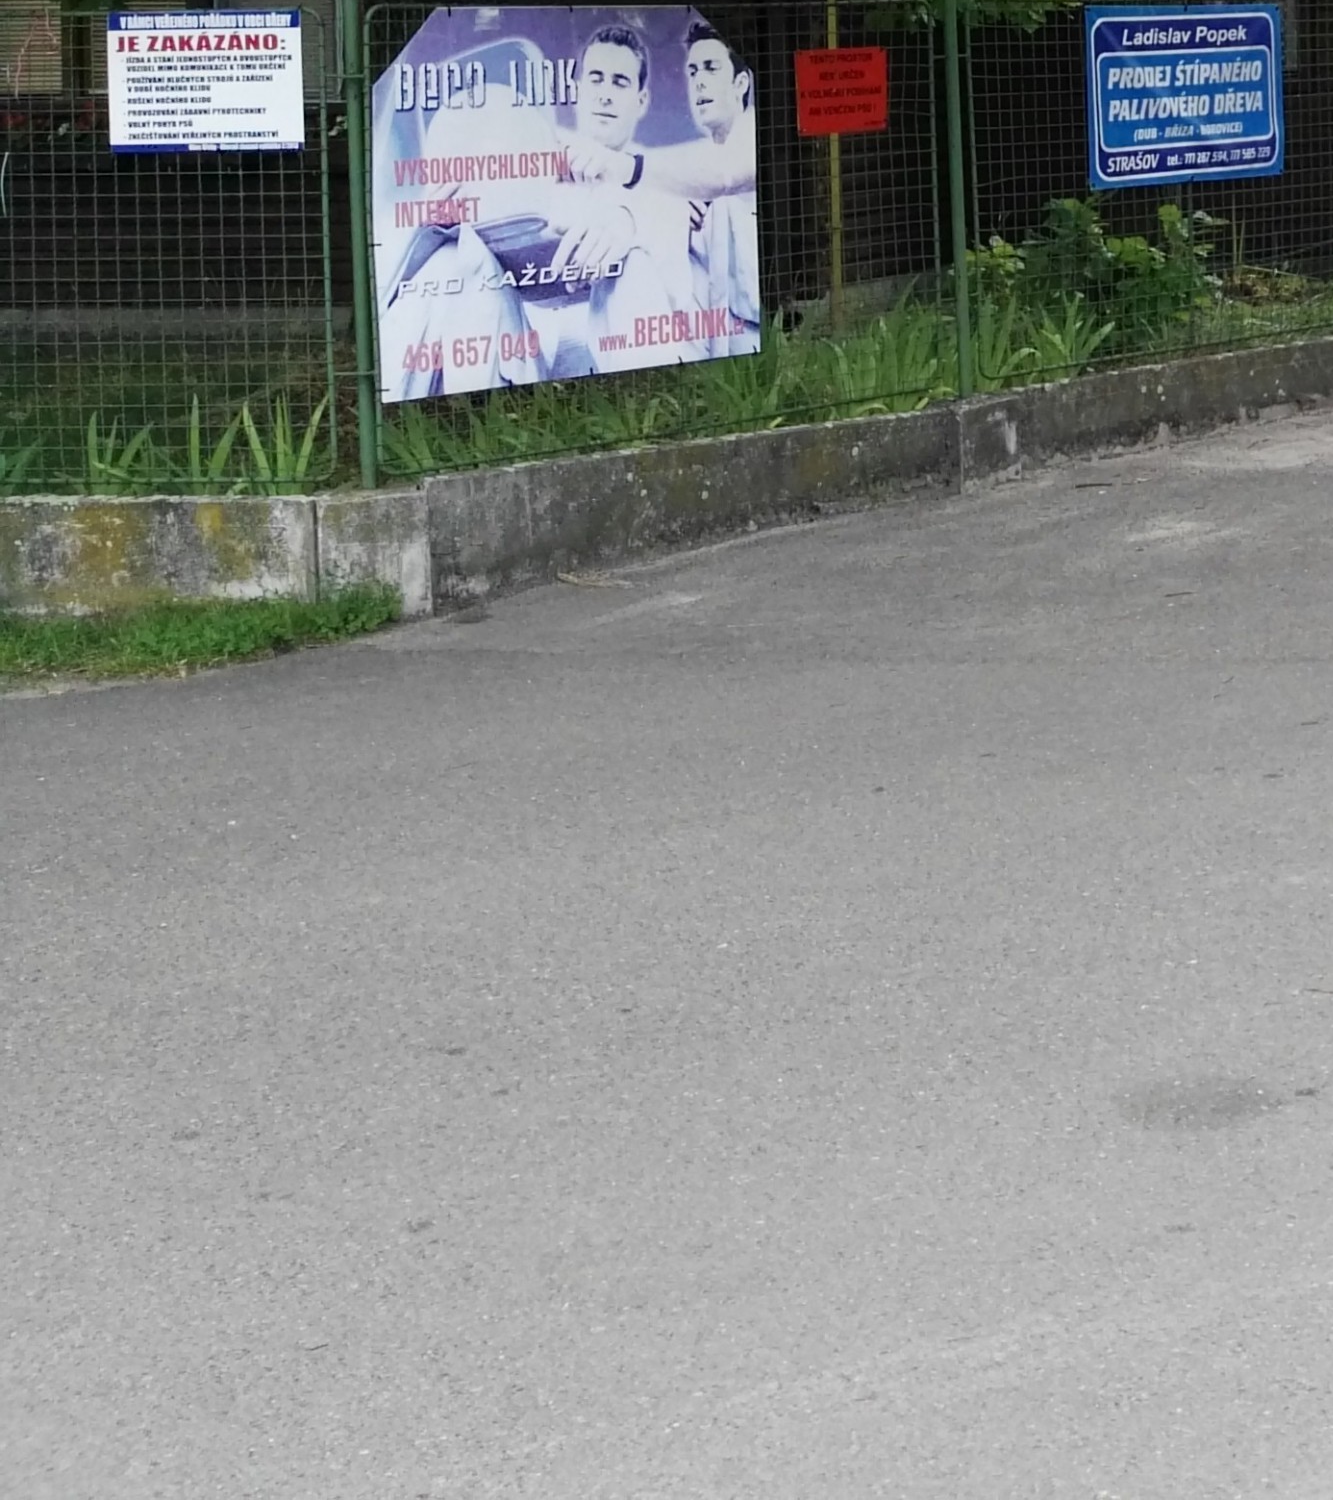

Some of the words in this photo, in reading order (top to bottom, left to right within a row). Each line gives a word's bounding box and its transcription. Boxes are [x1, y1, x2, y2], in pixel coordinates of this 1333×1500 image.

[116, 36, 140, 53] JE
[146, 31, 286, 52] ZAKÁZÁNO:
[1122, 28, 1191, 46] Ladislav
[1195, 25, 1247, 46] Popek
[1107, 65, 1171, 90] PRODEJ
[1108, 91, 1209, 122] PALIVOVÉHO
[1213, 87, 1264, 115] DŘEVA
[394, 145, 570, 187] VYSOKORYCHLOSTNÍ
[1106, 151, 1160, 173] STRAŠOV
[395, 197, 480, 229] INTERNET
[397, 276, 464, 300] PRO
[479, 260, 625, 291] KAŽDÉHO
[402, 341, 444, 373] 466
[452, 335, 492, 368] 657
[501, 329, 541, 363] 049
